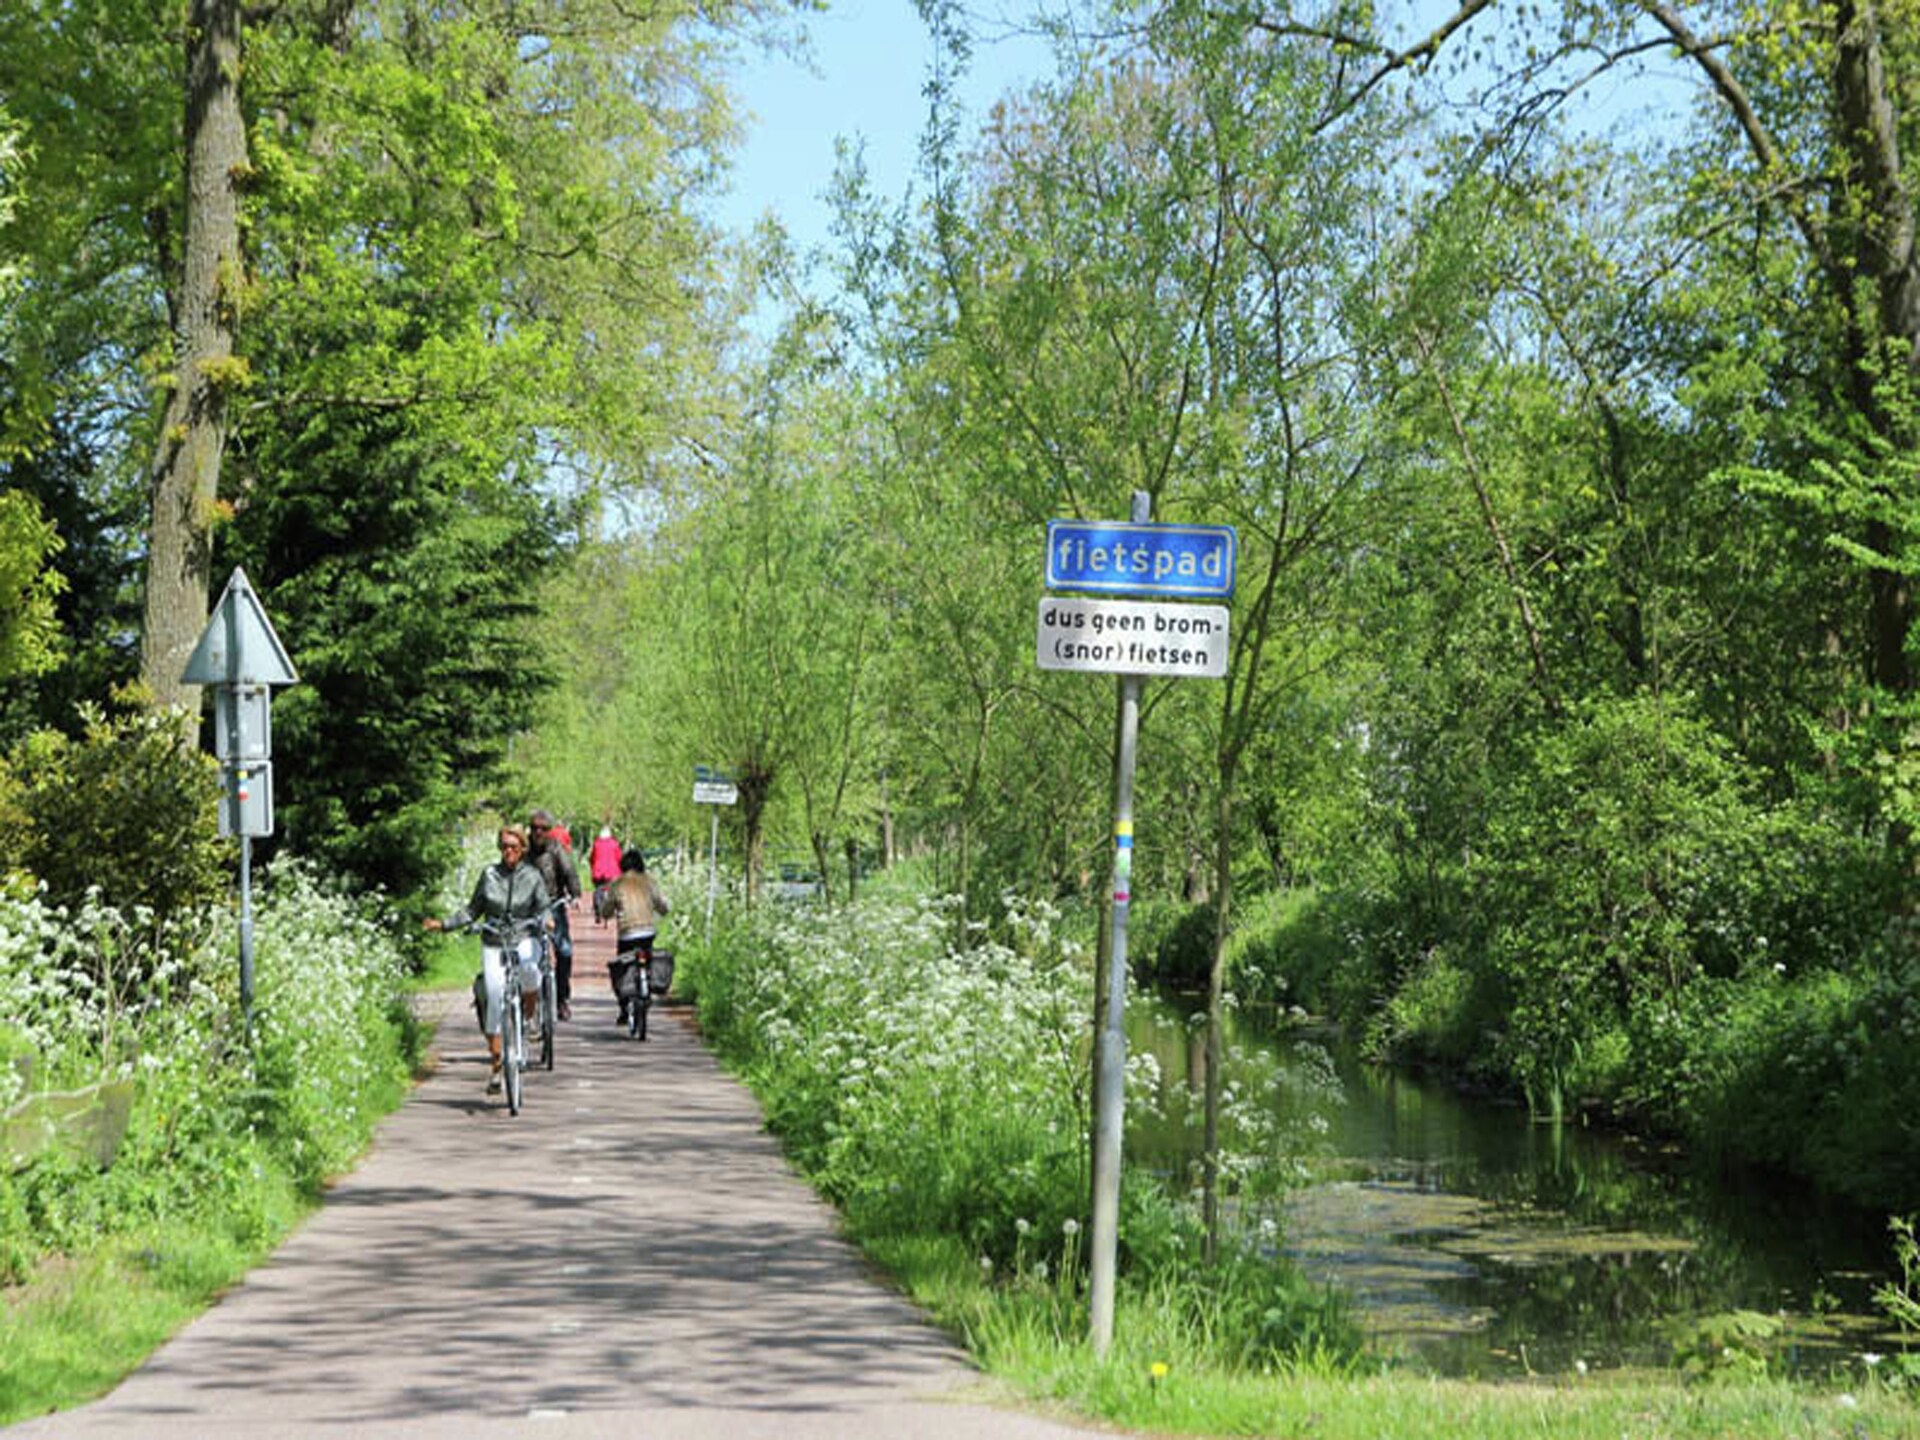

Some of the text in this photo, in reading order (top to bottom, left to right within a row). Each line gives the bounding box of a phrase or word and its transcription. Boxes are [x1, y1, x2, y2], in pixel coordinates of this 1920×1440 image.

[1058, 539, 1221, 580] fietspad
[1044, 608, 1223, 635] dus geen brom-
